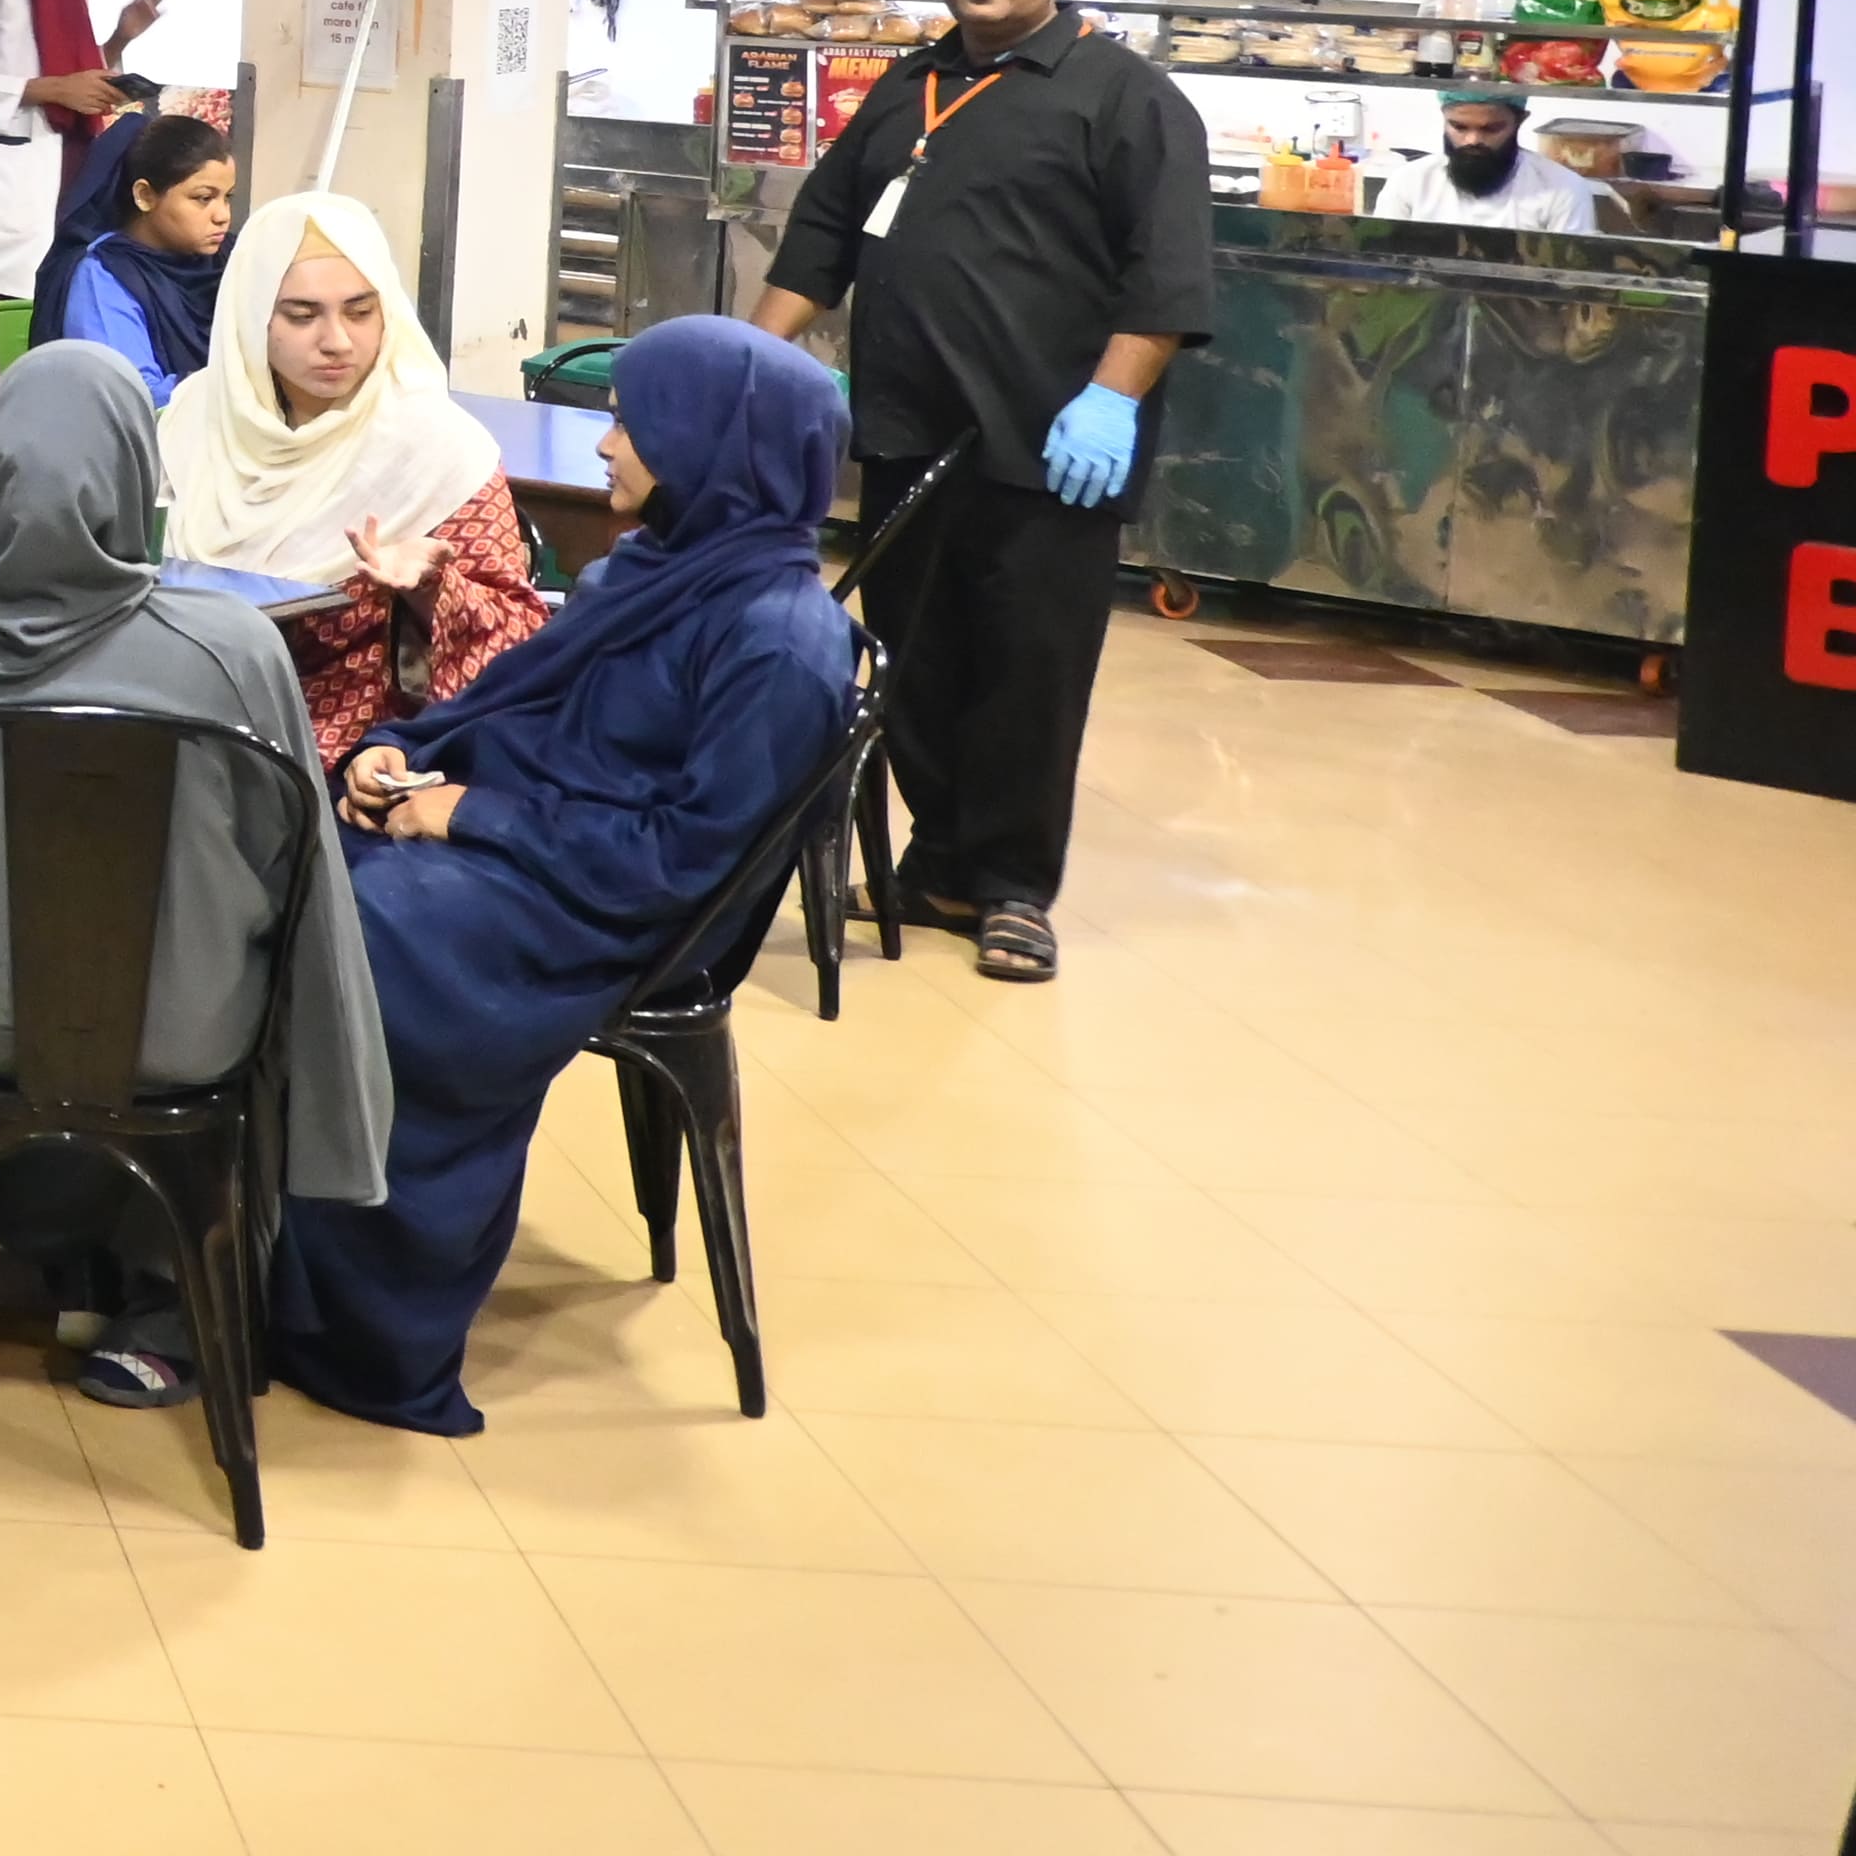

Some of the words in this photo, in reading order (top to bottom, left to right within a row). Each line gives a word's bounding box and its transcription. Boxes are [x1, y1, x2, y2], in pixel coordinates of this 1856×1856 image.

[330, 1, 355, 11] cafe
[323, 17, 352, 28] more
[330, 32, 342, 44] 15
[850, 48, 870, 58] FAST
[872, 48, 898, 58] FOOD
[748, 60, 791, 70] FLAME
[828, 57, 890, 80] MENU
